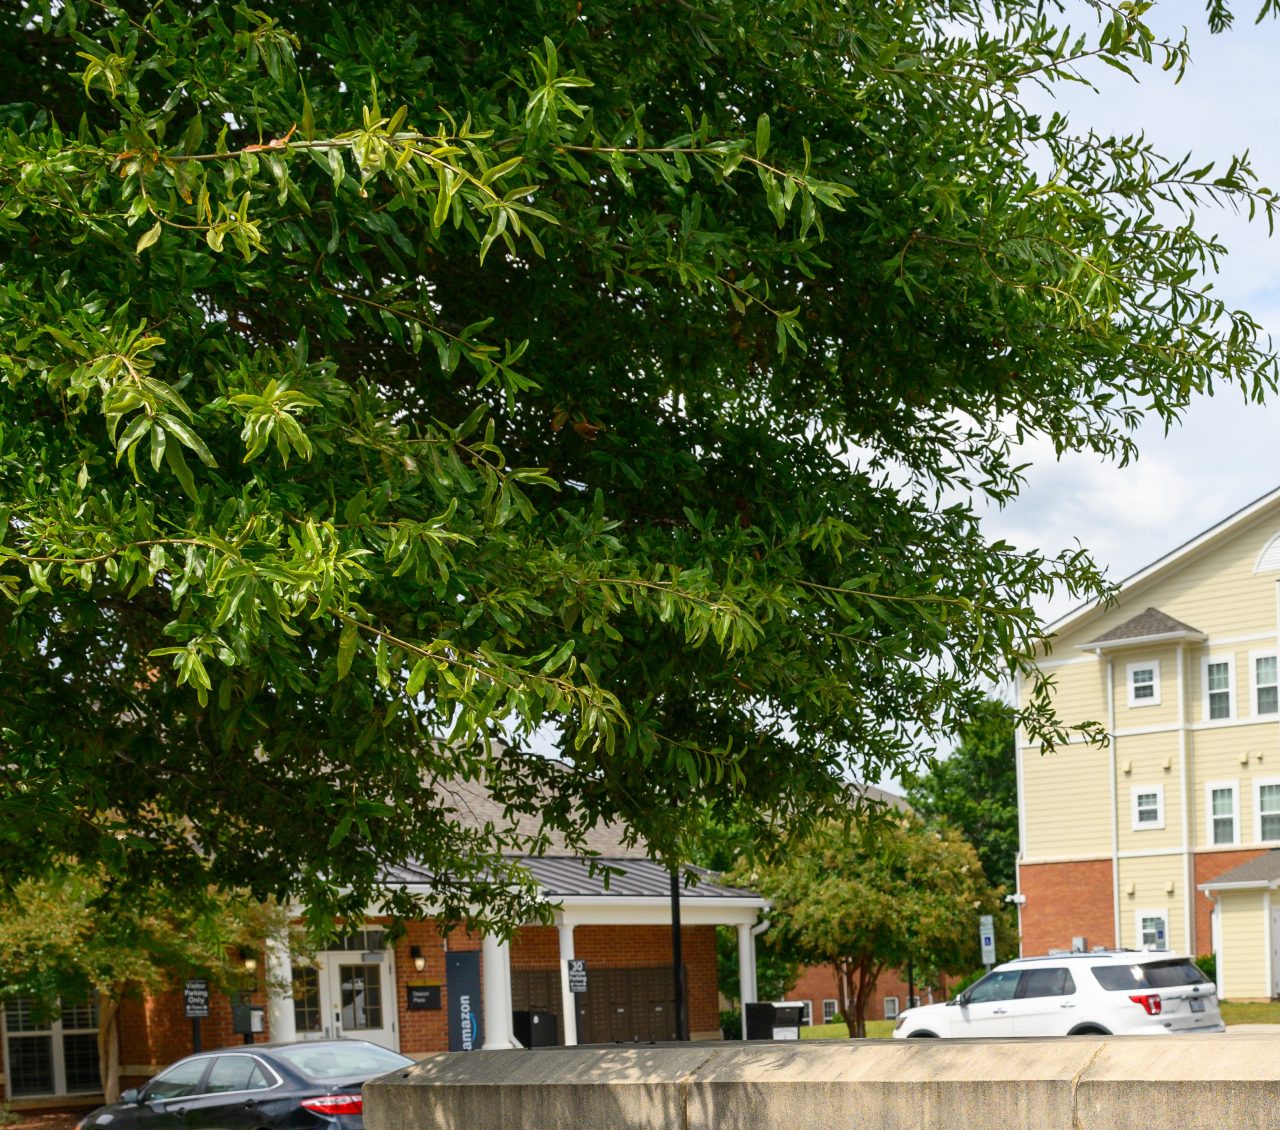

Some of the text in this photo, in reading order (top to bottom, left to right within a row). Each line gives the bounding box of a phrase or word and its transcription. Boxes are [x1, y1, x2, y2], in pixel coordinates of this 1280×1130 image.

[572, 961, 583, 971] 30
[184, 989, 208, 998] Parking
[187, 996, 205, 1005] Only
[460, 995, 473, 1050] amazon
